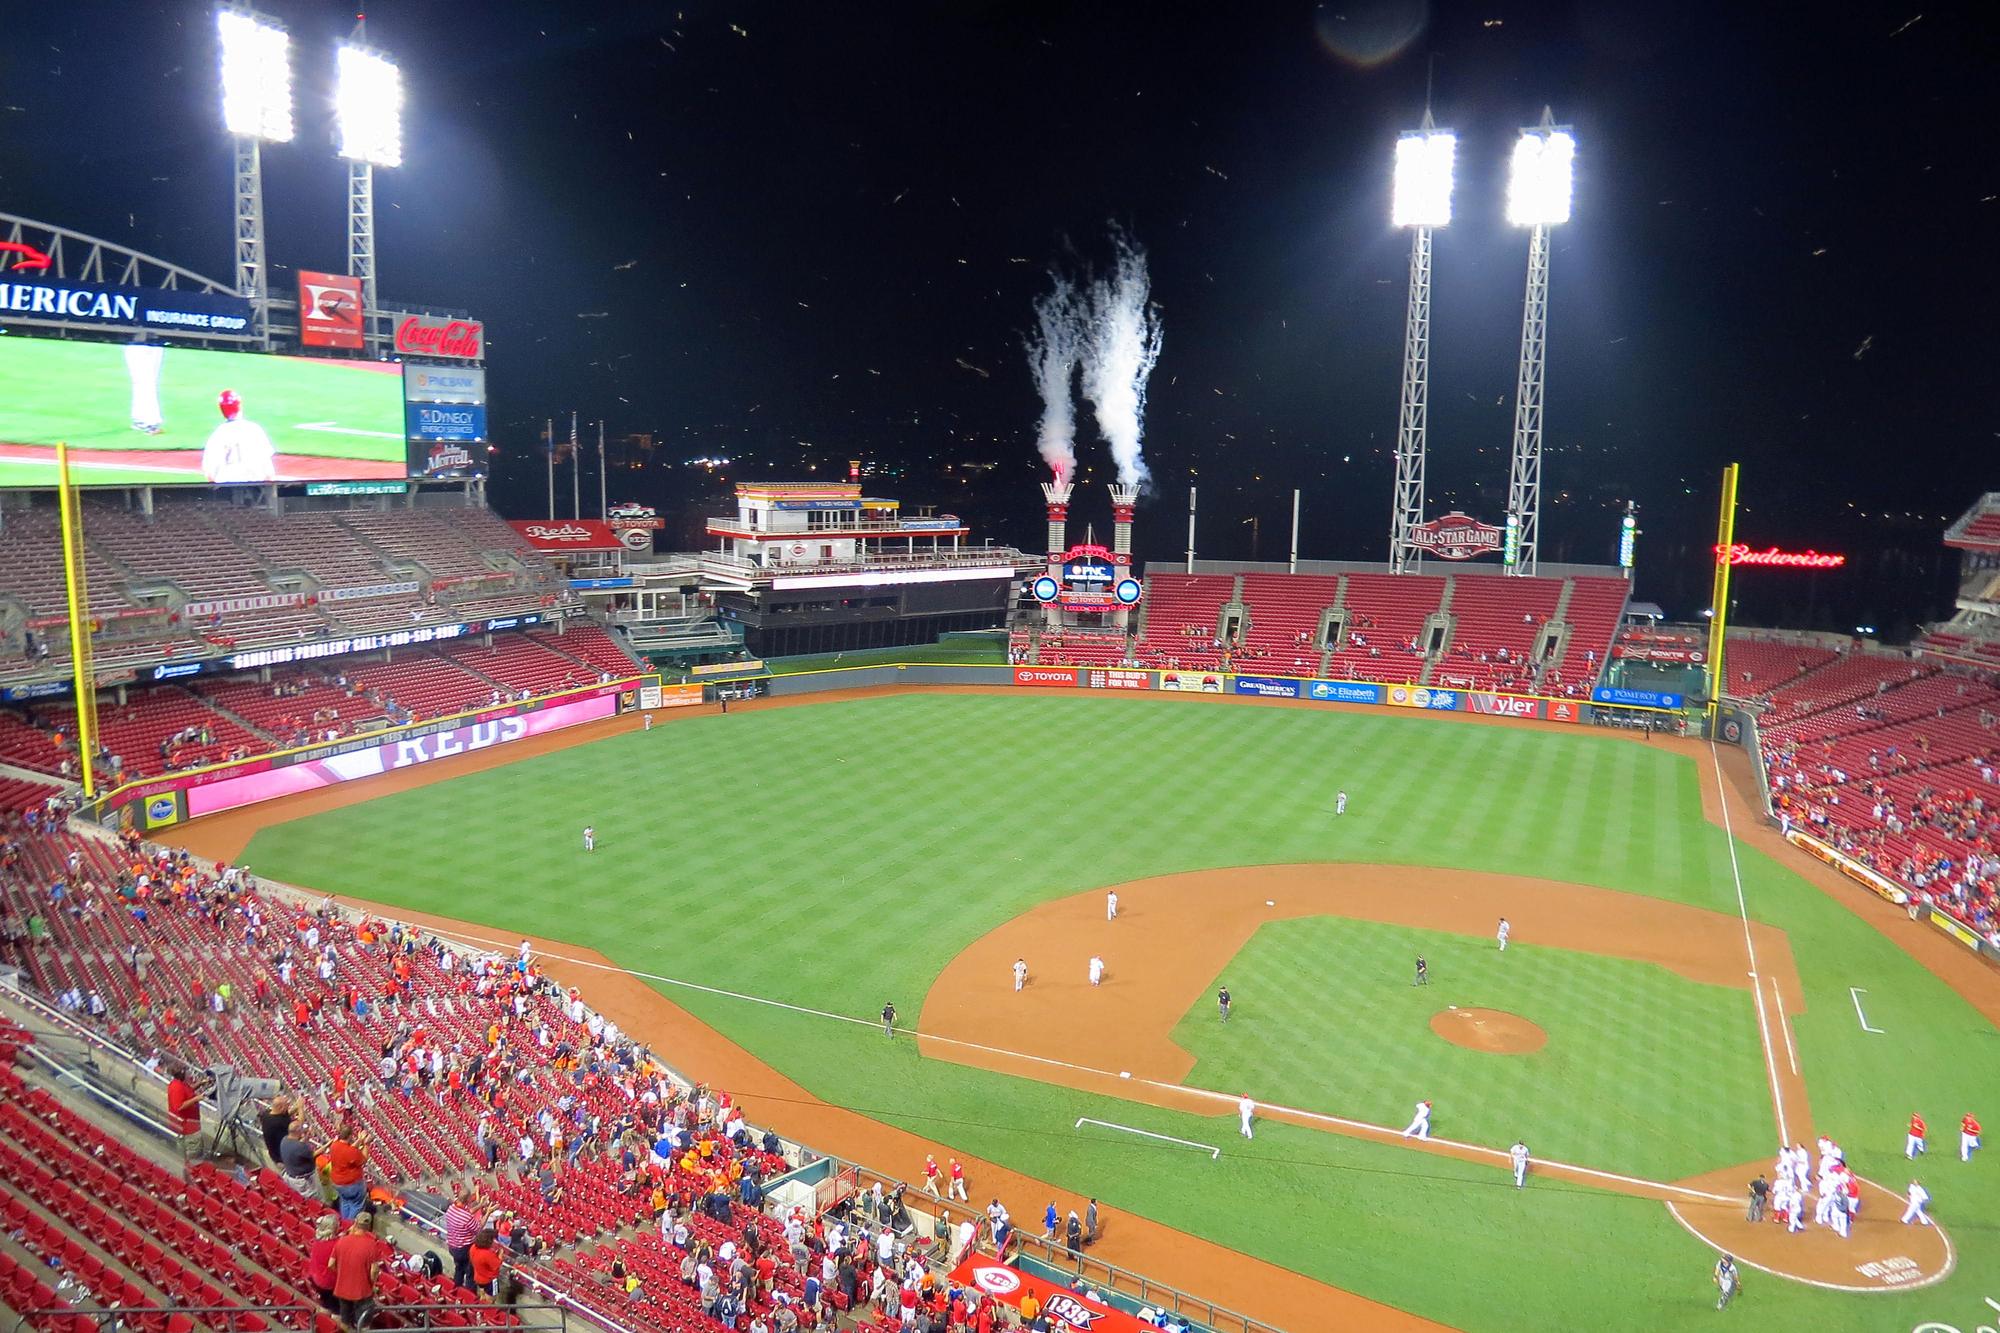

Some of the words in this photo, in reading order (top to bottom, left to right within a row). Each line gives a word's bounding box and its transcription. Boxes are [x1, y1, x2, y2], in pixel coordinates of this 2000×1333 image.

[210, 316, 246, 329] GROUP
[526, 524, 592, 540] Reds
[1466, 529, 1497, 544] GAME
[1713, 543, 1845, 567] Budweiser
[1083, 566, 1106, 576] PNC
[1035, 672, 1073, 682] TOYOTA
[1108, 671, 1124, 679] THIS
[1108, 679, 1122, 688] FOR
[1338, 686, 1375, 697] Elizabeth
[984, 1272, 1017, 1290] REDS
[1049, 1296, 1091, 1324] 1939
